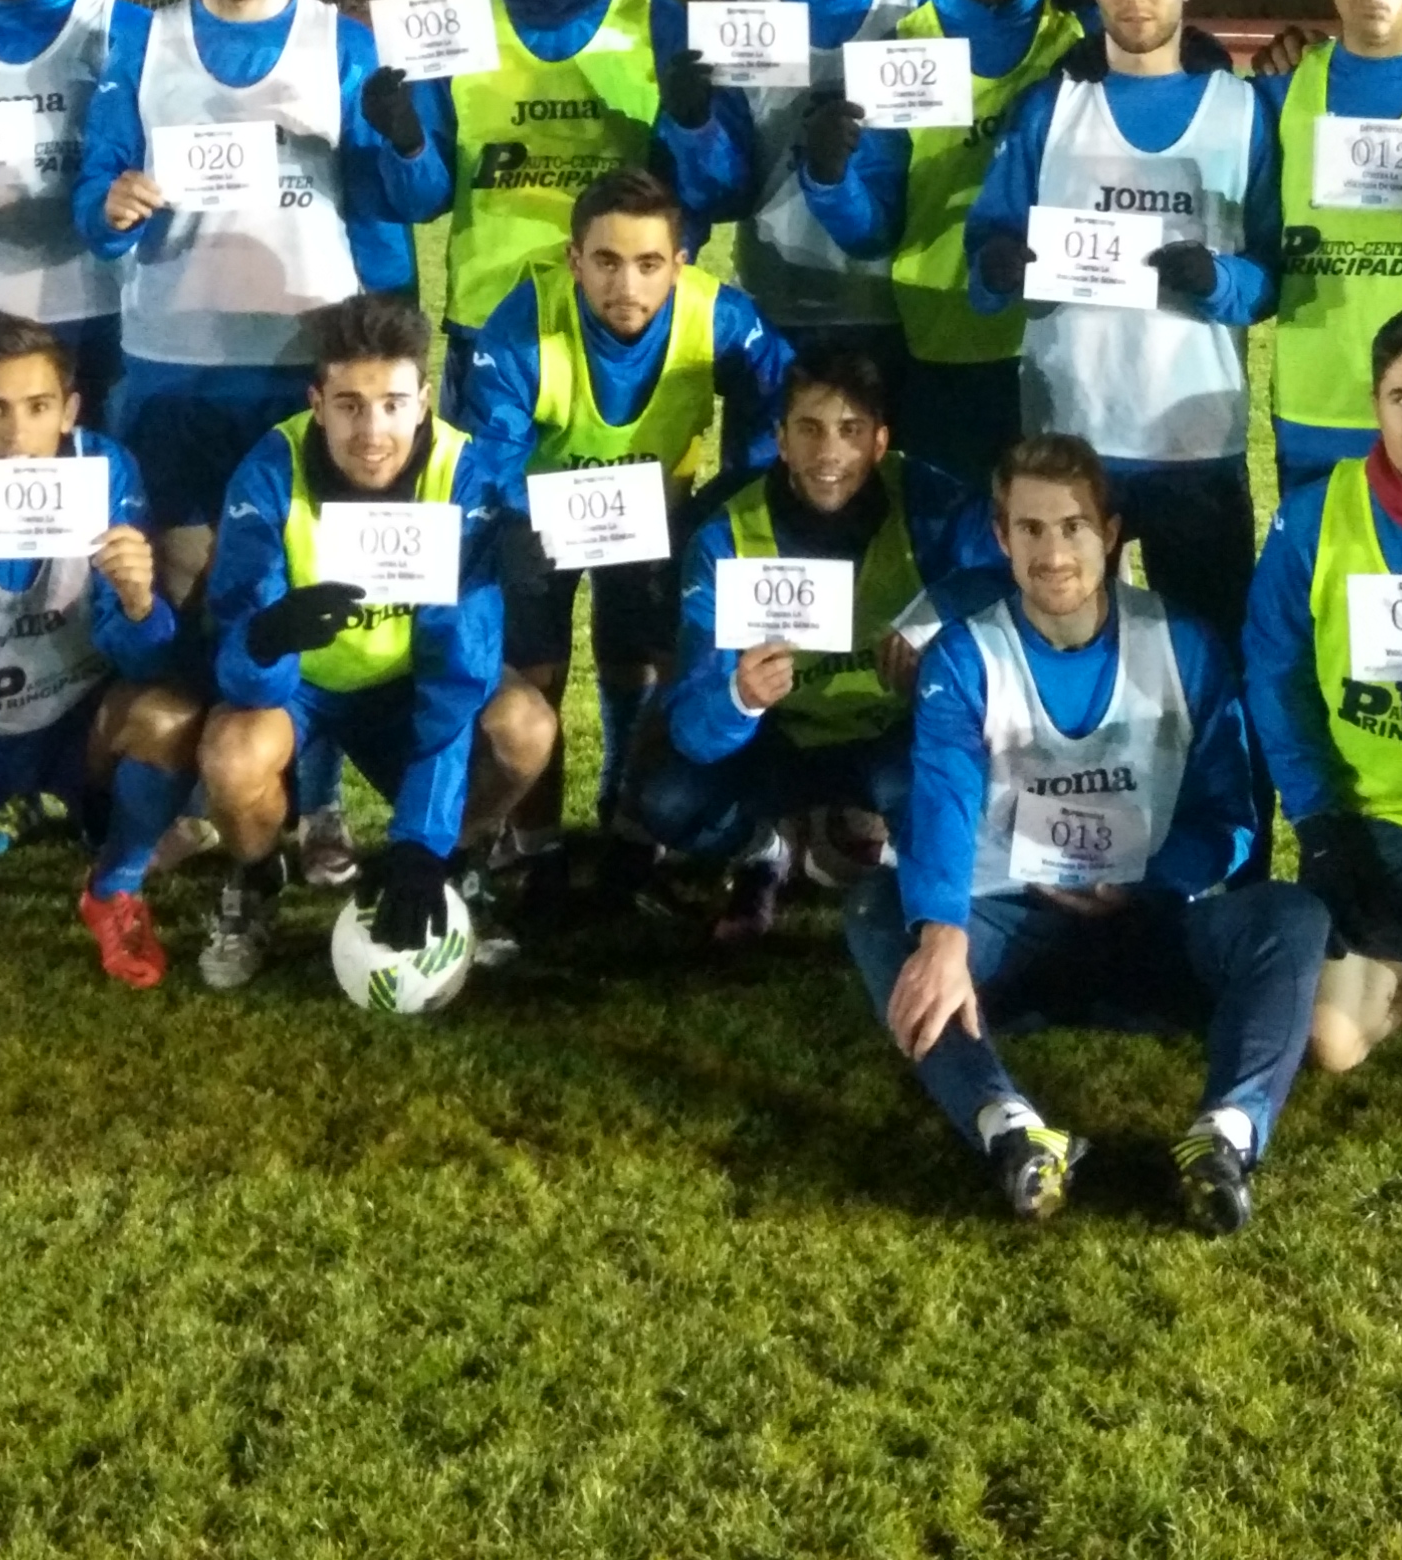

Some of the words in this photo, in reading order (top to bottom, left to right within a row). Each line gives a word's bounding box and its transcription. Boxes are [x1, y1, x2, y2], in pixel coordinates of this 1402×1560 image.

[405, 8, 461, 39] 008
[720, 21, 776, 47] 010
[880, 59, 937, 87] 002
[511, 100, 600, 126] Joma
[188, 143, 244, 170] 020
[471, 142, 595, 189] PRINCIPA
[1095, 186, 1194, 215] Joma
[1065, 231, 1121, 262] 014
[5, 481, 64, 511] 001
[568, 489, 626, 521] 004
[360, 525, 421, 556] 003
[754, 578, 815, 606] 006
[1027, 766, 1138, 796] Joma
[1051, 821, 1112, 851] 013
